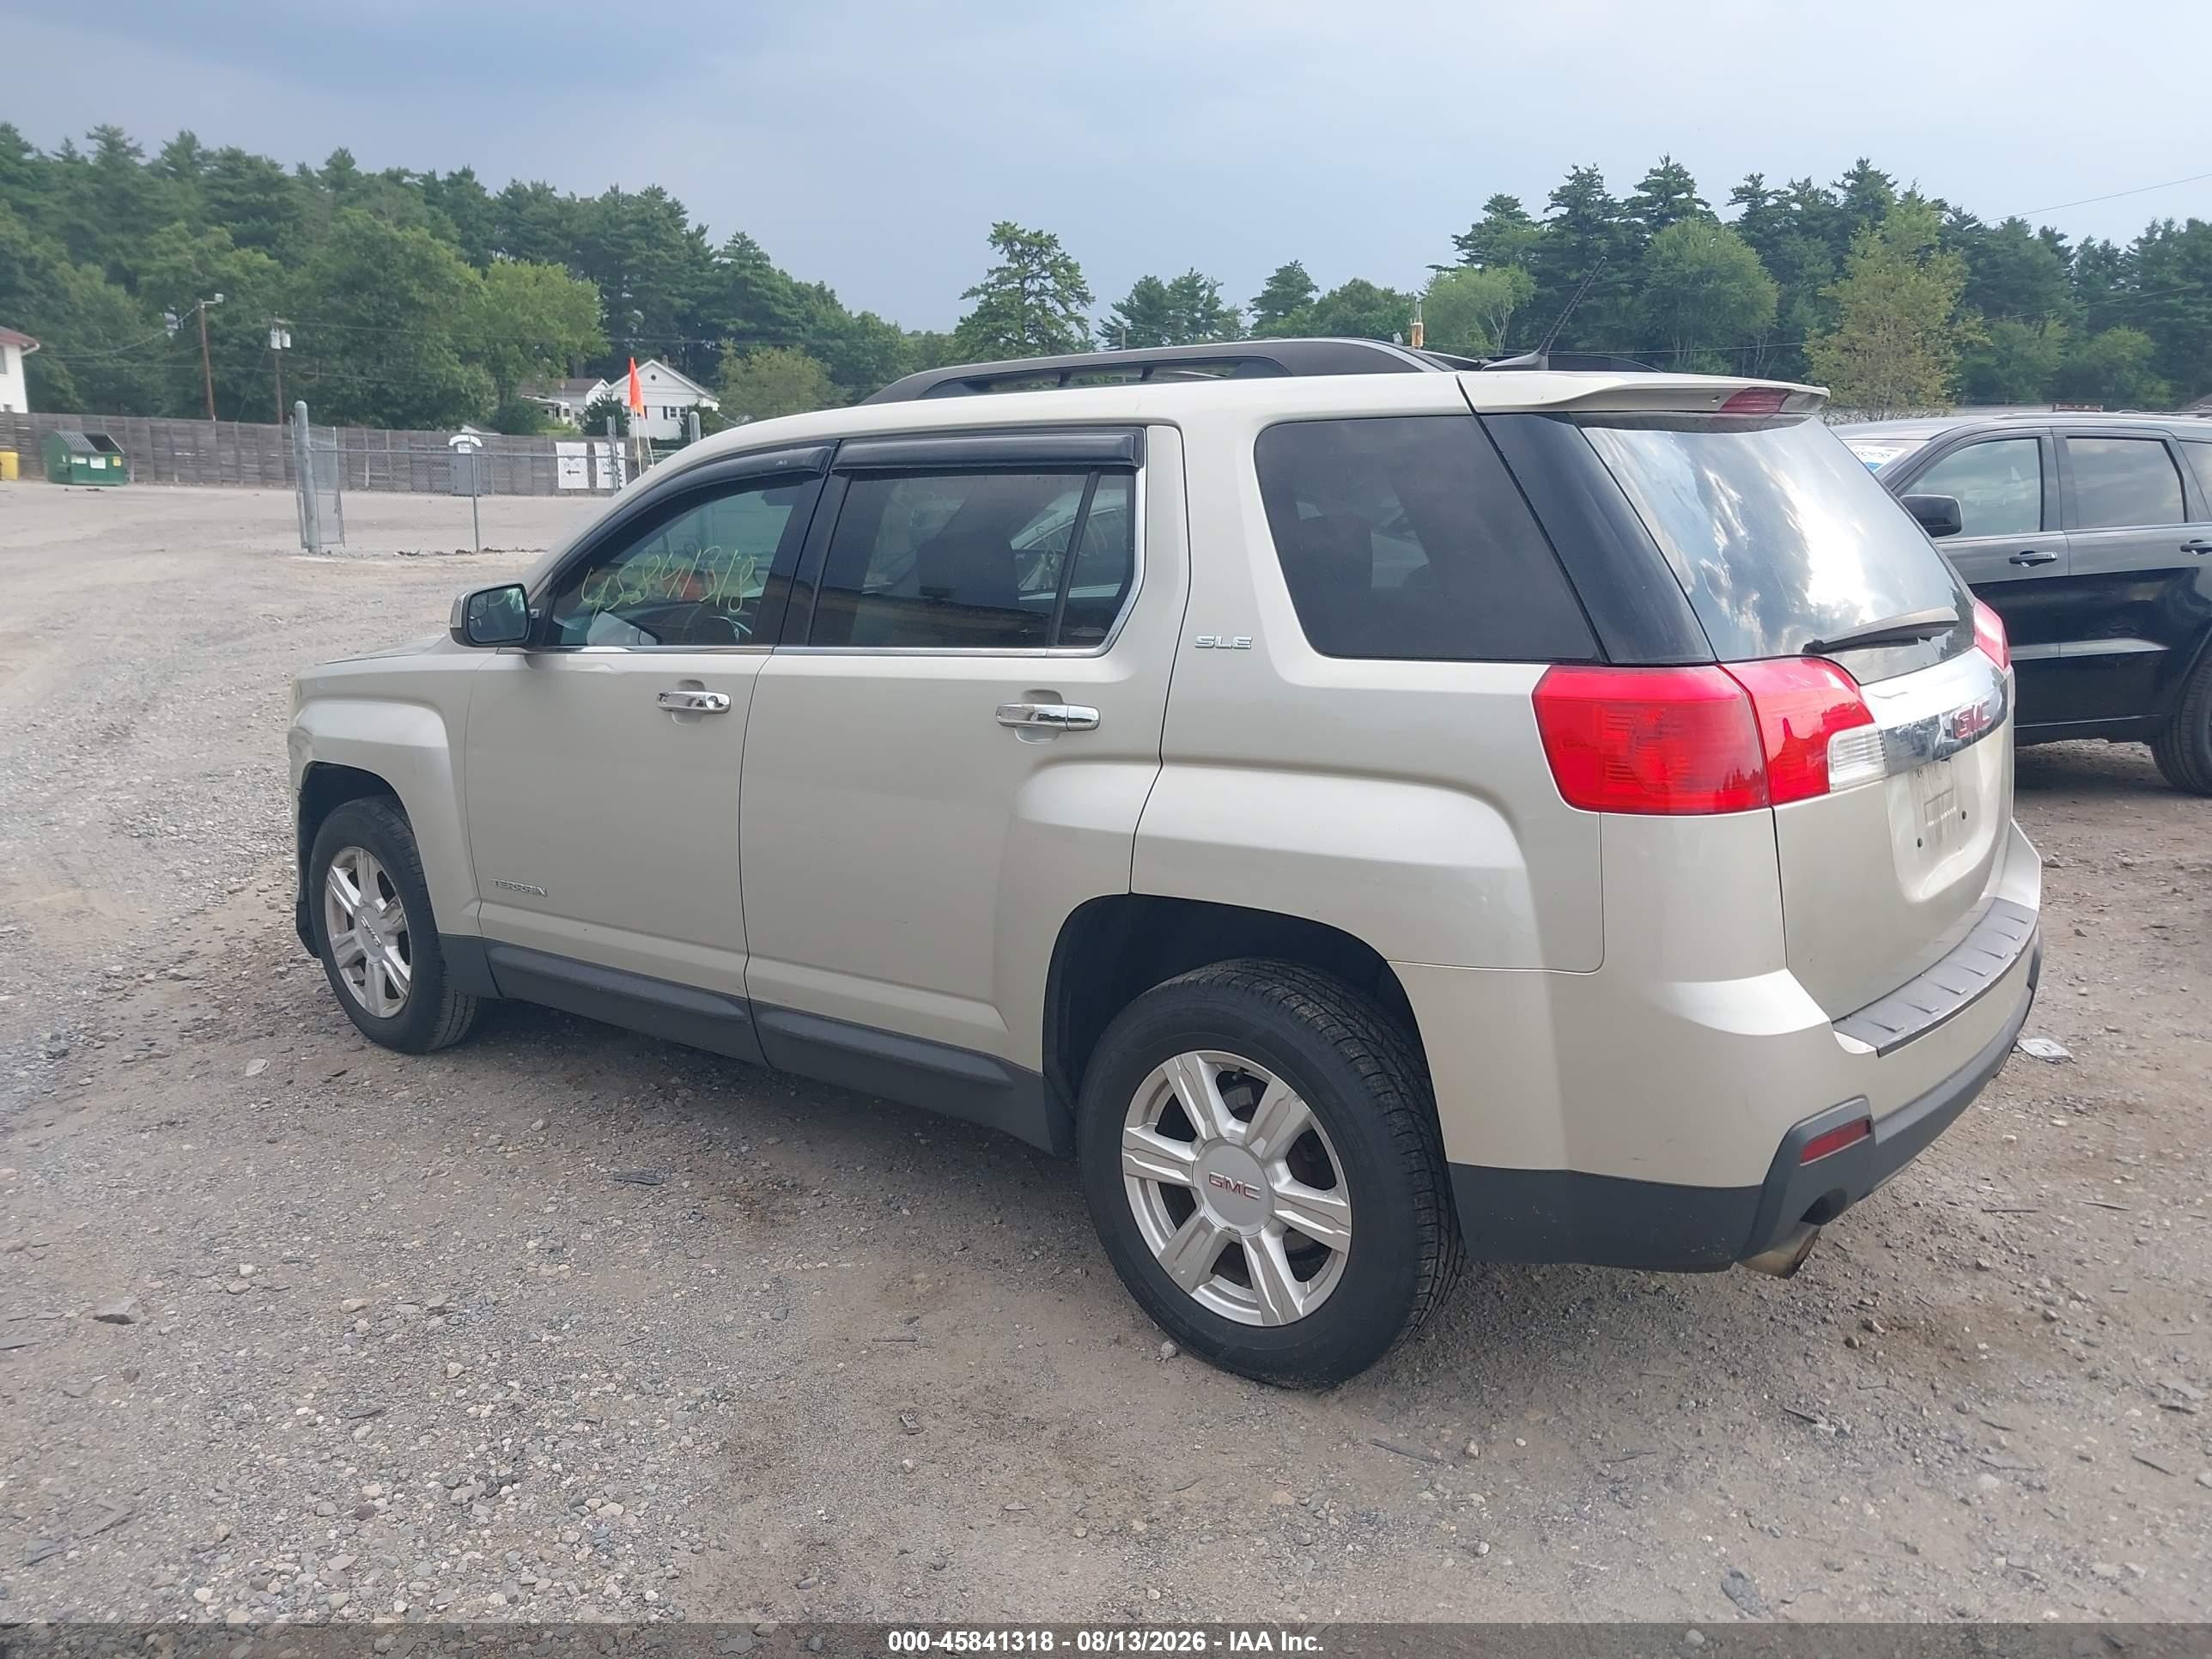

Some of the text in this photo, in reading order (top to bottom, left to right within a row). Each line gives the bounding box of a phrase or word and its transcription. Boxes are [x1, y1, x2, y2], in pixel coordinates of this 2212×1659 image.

[581, 545, 758, 623] 45841318
[1194, 635, 1252, 649] SLE
[1209, 1171, 1261, 1200] GMC
